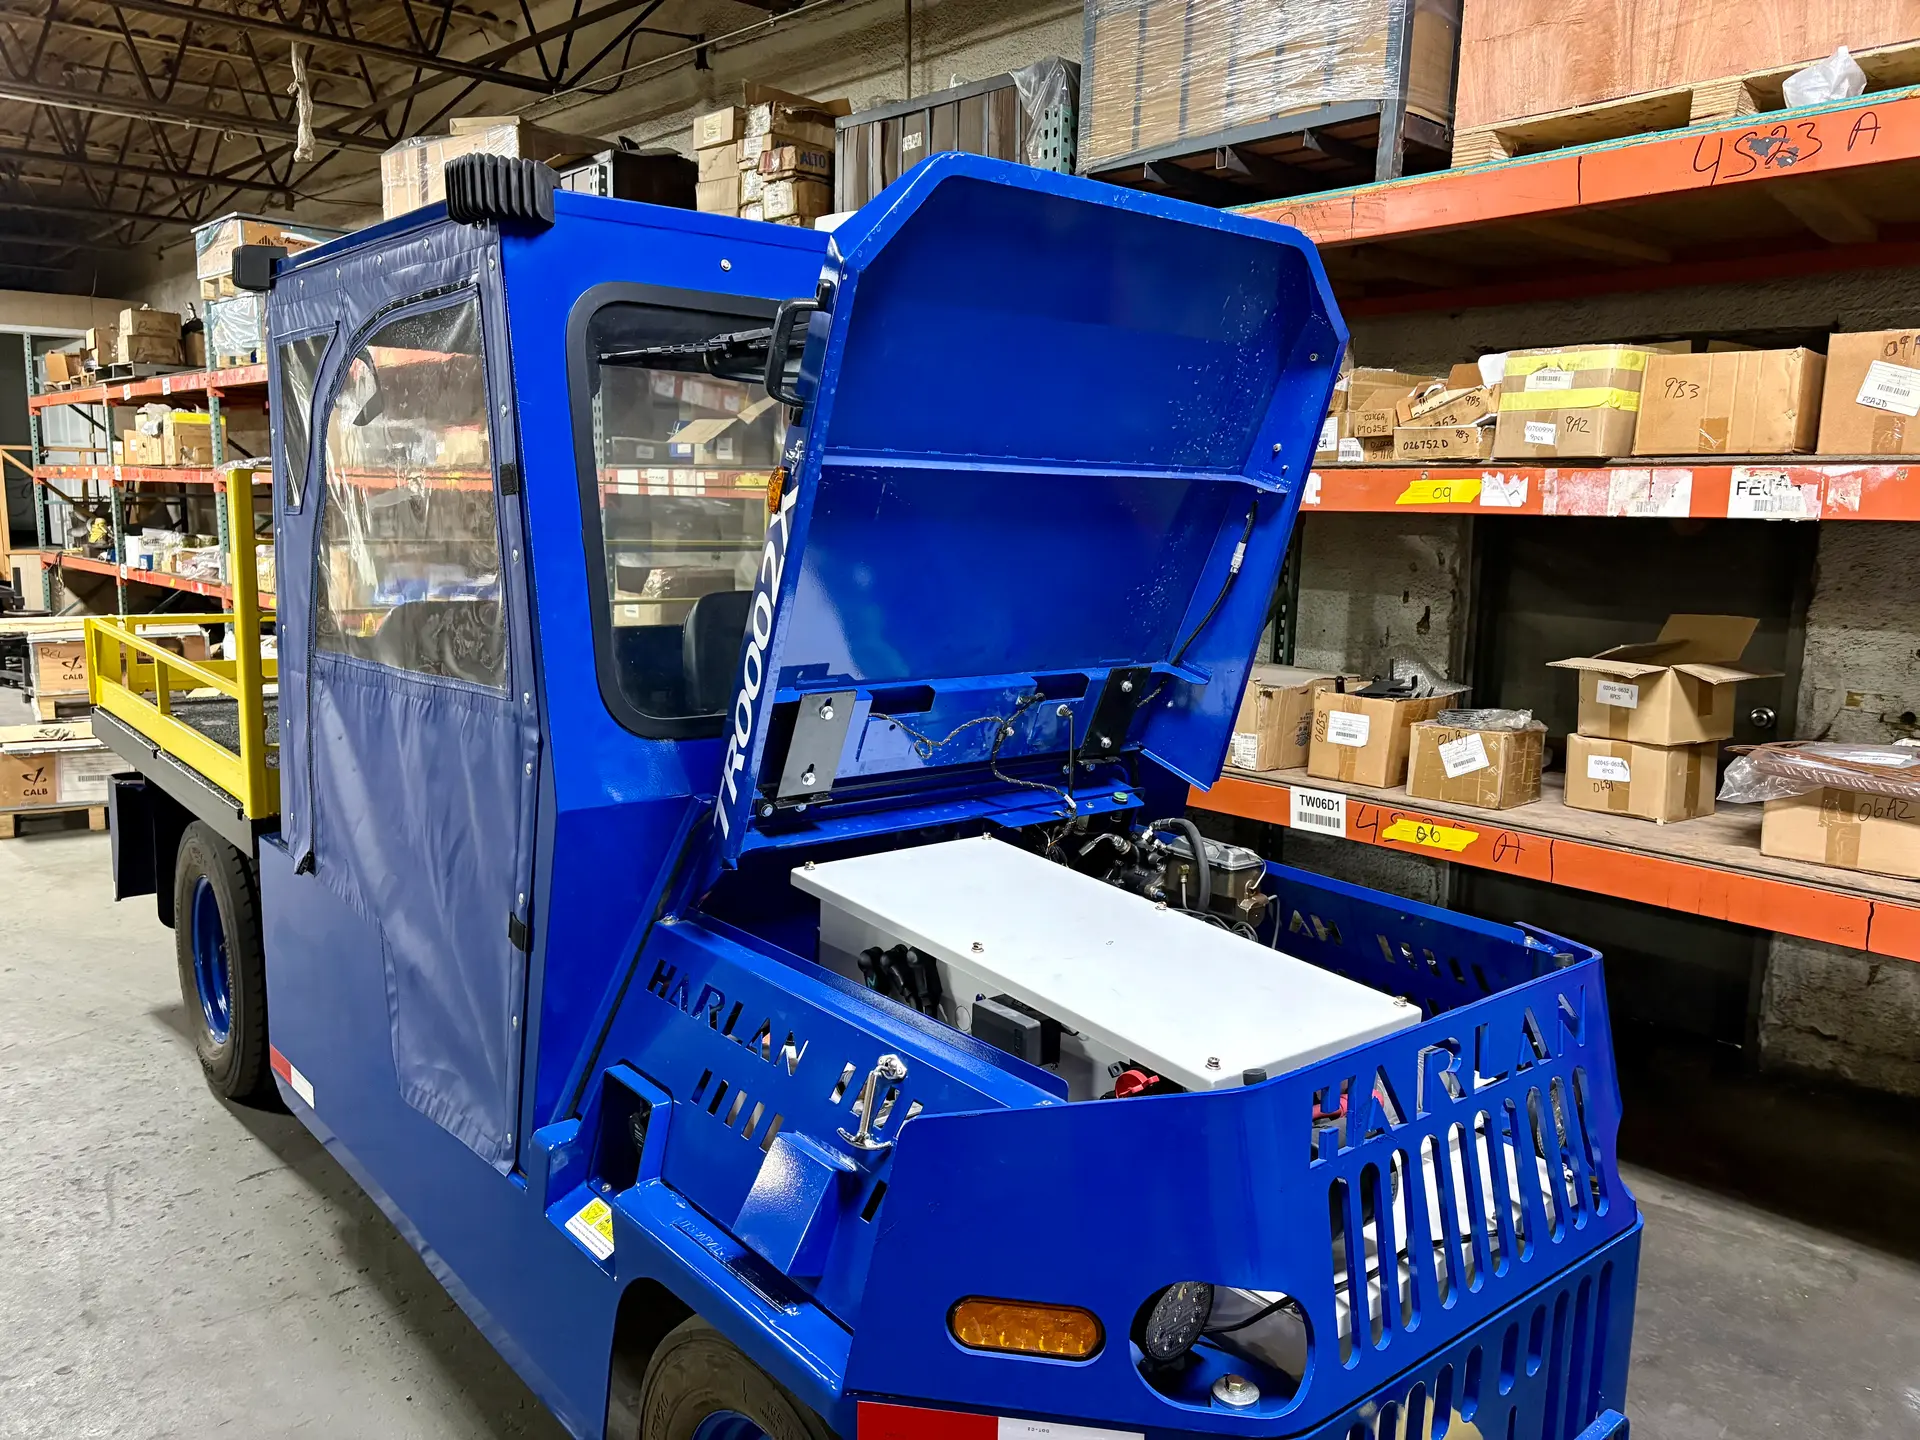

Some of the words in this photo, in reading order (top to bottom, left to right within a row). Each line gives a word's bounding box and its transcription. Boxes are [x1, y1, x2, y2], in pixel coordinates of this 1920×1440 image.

[1847, 111, 1881, 151] A
[801, 151, 826, 169] ALTO
[1664, 377, 1700, 399] 9B3
[1565, 416, 1590, 433] 9A2
[1432, 486, 1451, 503] 09
[62, 672, 84, 681] CALB
[23, 788, 48, 797] CALB
[1299, 794, 1340, 812] TW06D1
[646, 958, 809, 1076] HARLAN
[1310, 984, 1586, 1169] HARLAN
